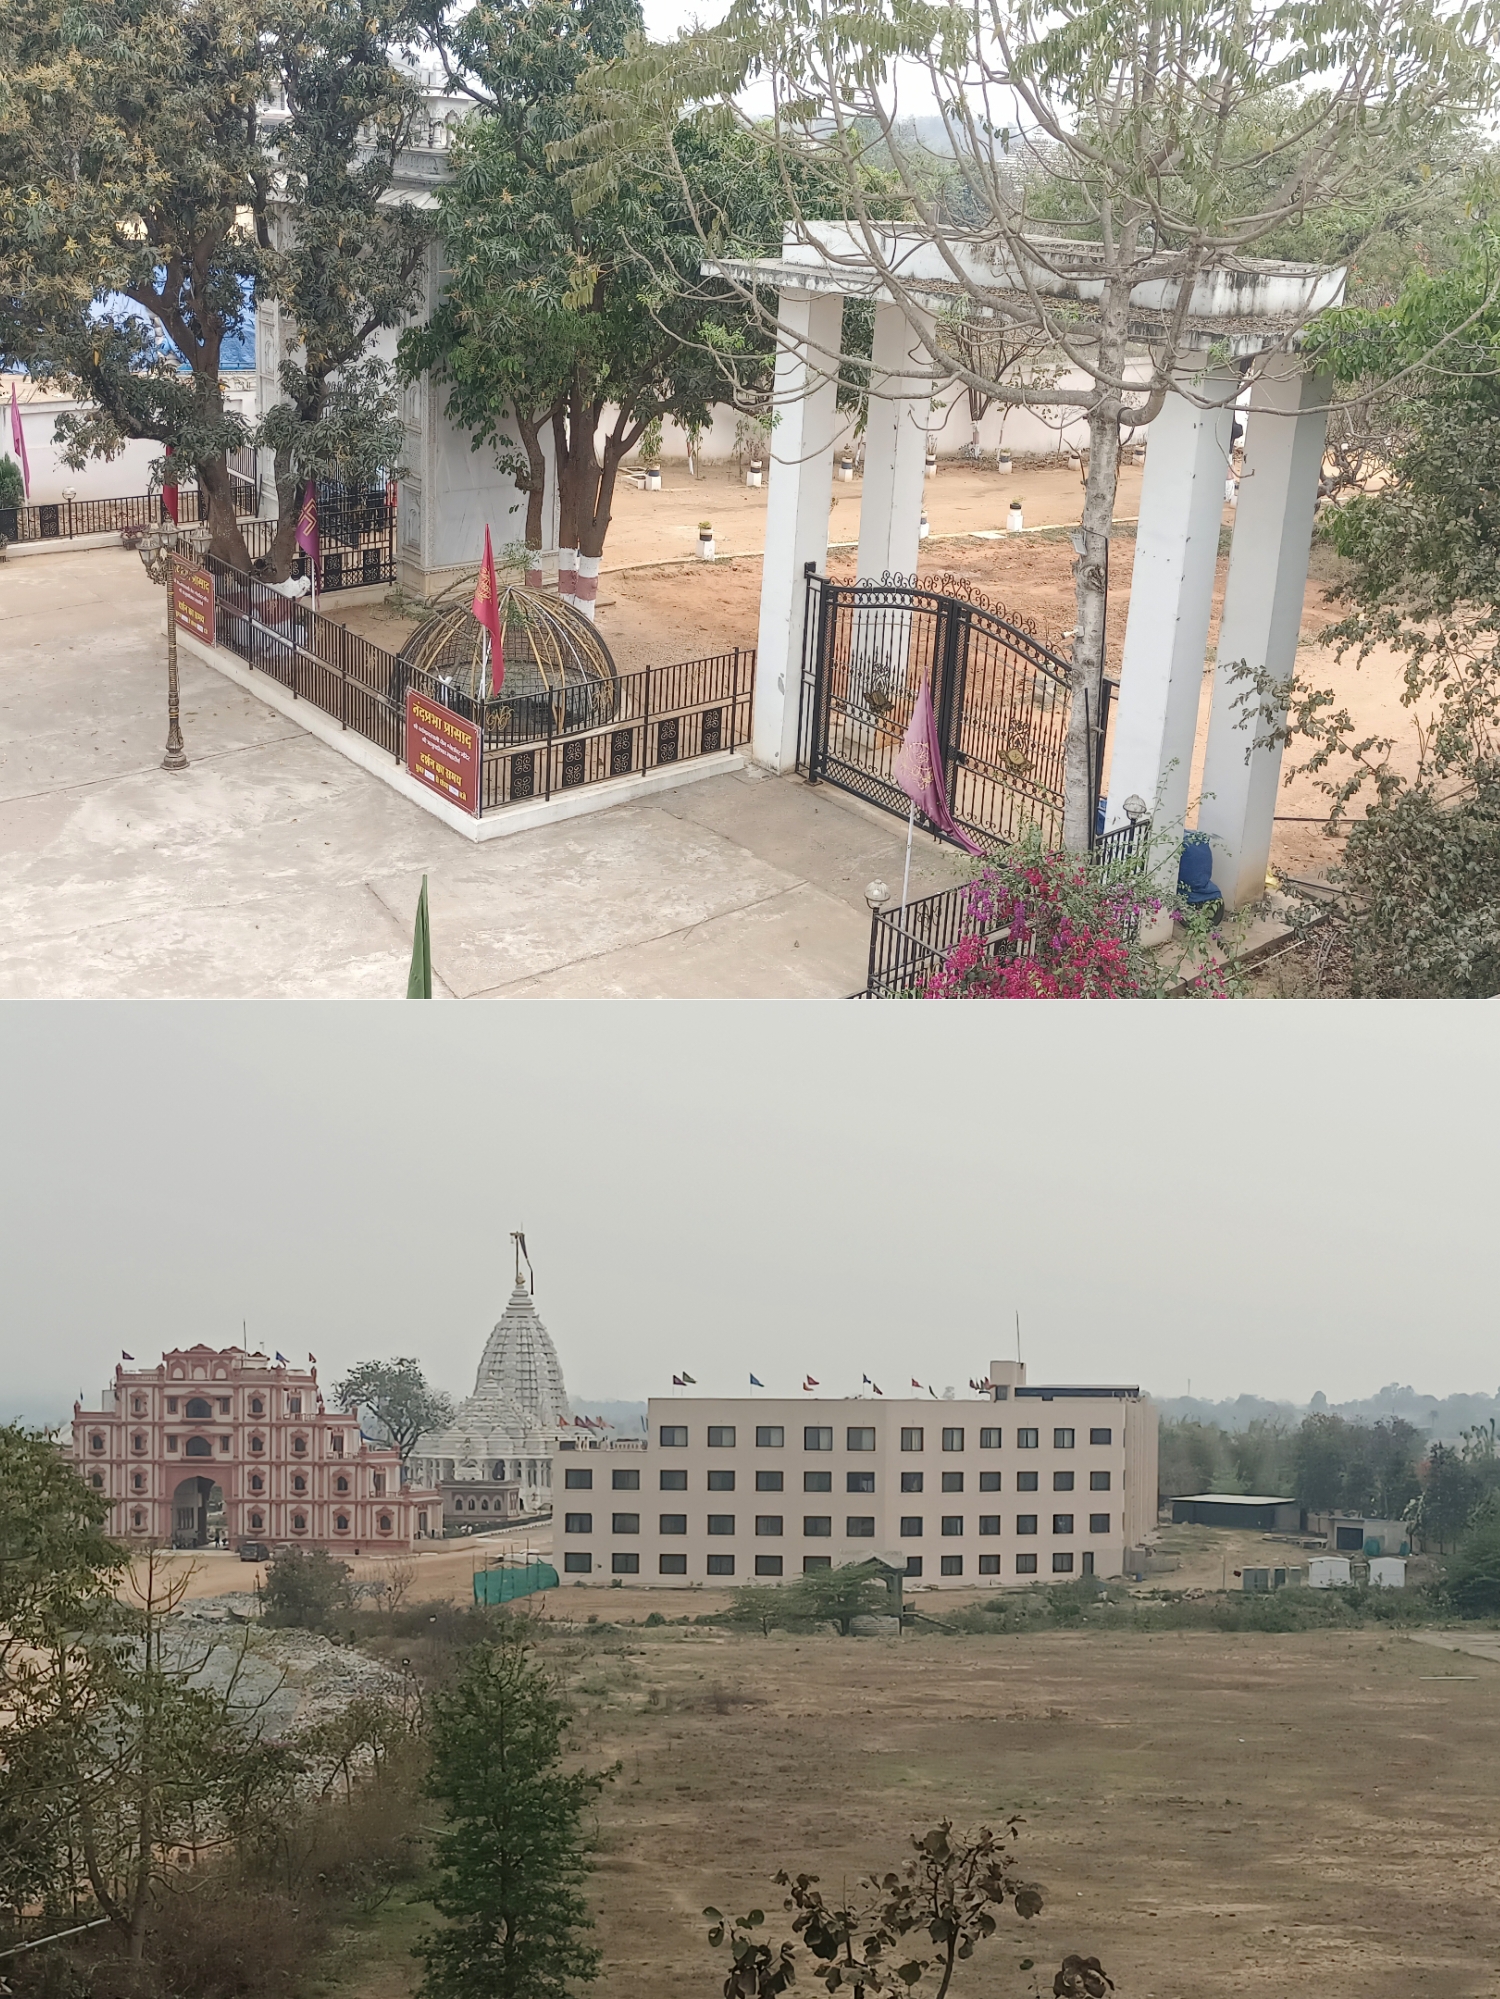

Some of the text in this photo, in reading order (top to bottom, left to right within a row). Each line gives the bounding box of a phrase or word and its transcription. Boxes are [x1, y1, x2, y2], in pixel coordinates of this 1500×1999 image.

[412, 700, 442, 730] नंदप्रभा
[443, 721, 472, 750] प्रासाद
[419, 752, 435, 770] दर्शन
[435, 762, 446, 776] का
[445, 768, 462, 787] समय
